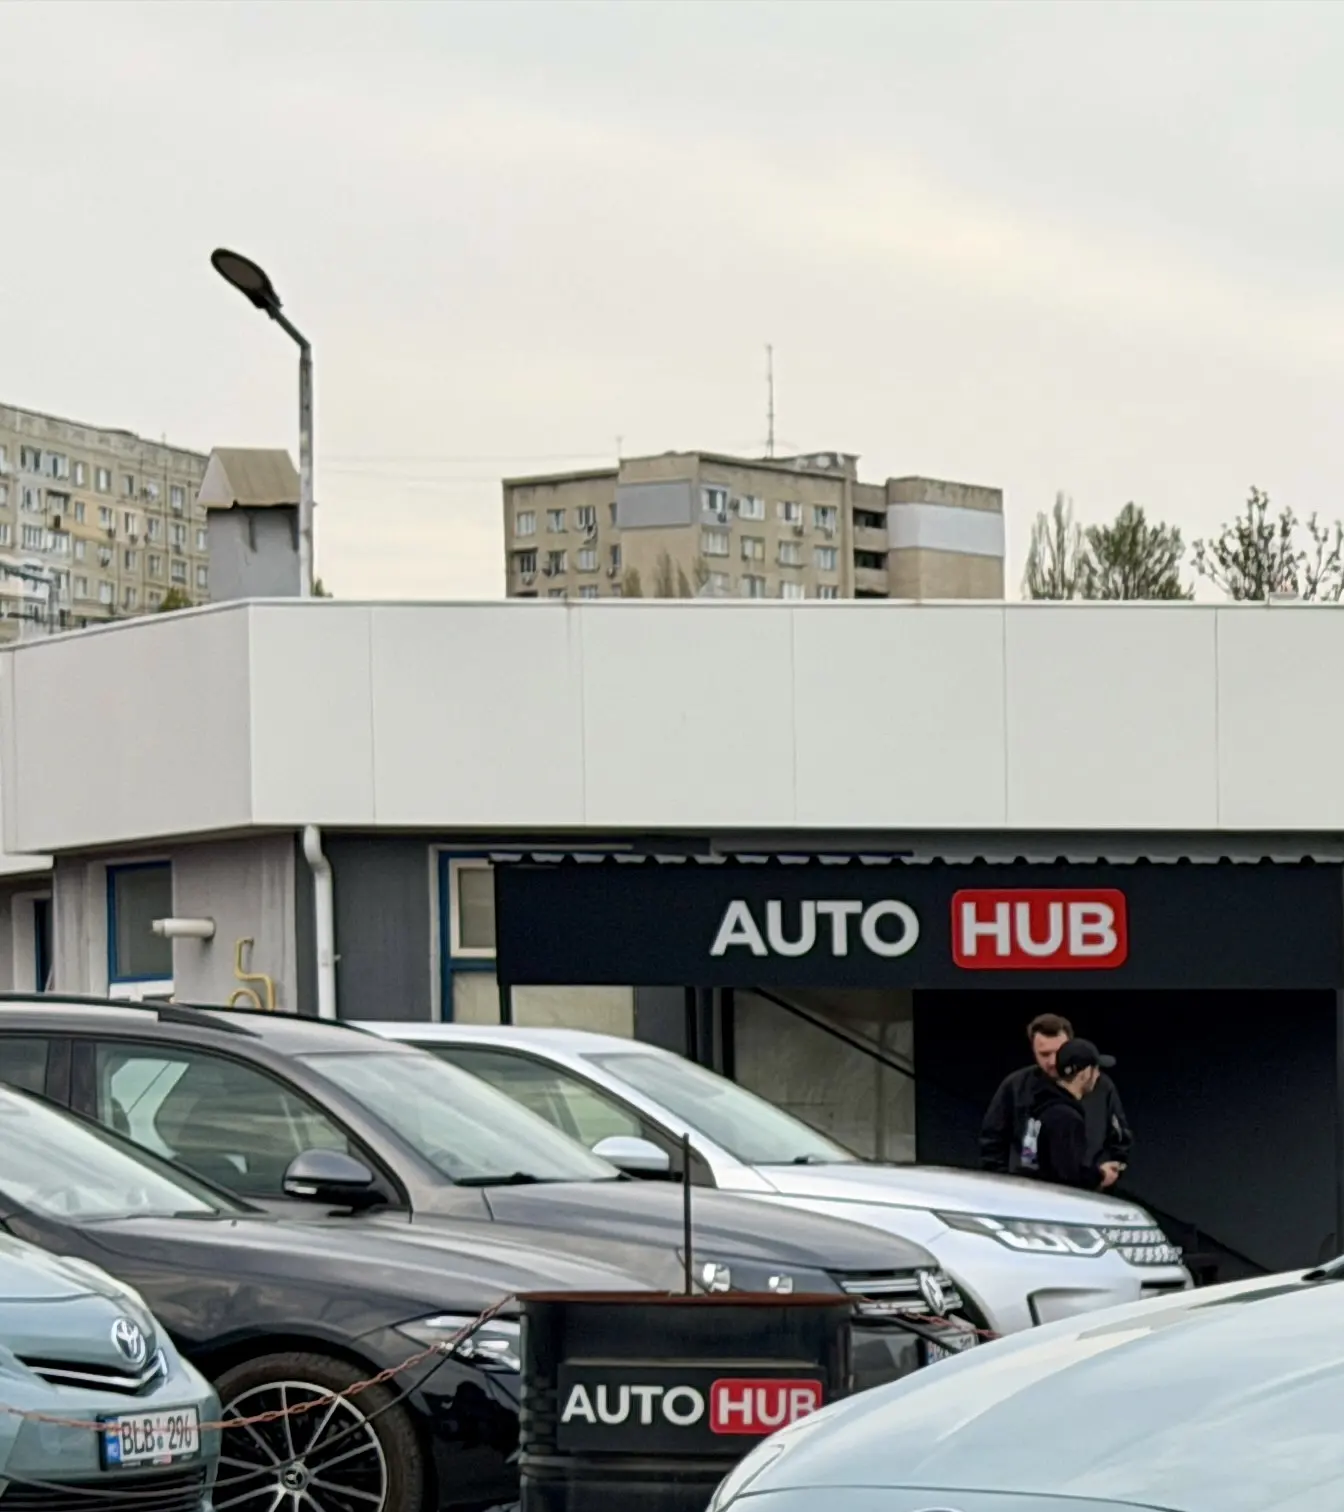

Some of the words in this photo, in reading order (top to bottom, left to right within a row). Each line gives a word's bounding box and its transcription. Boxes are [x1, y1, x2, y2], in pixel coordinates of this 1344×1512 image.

[709, 899, 920, 957] AUTO
[961, 901, 1118, 957] HUB
[560, 1383, 705, 1426] AUTO
[121, 1418, 155, 1455] BLB
